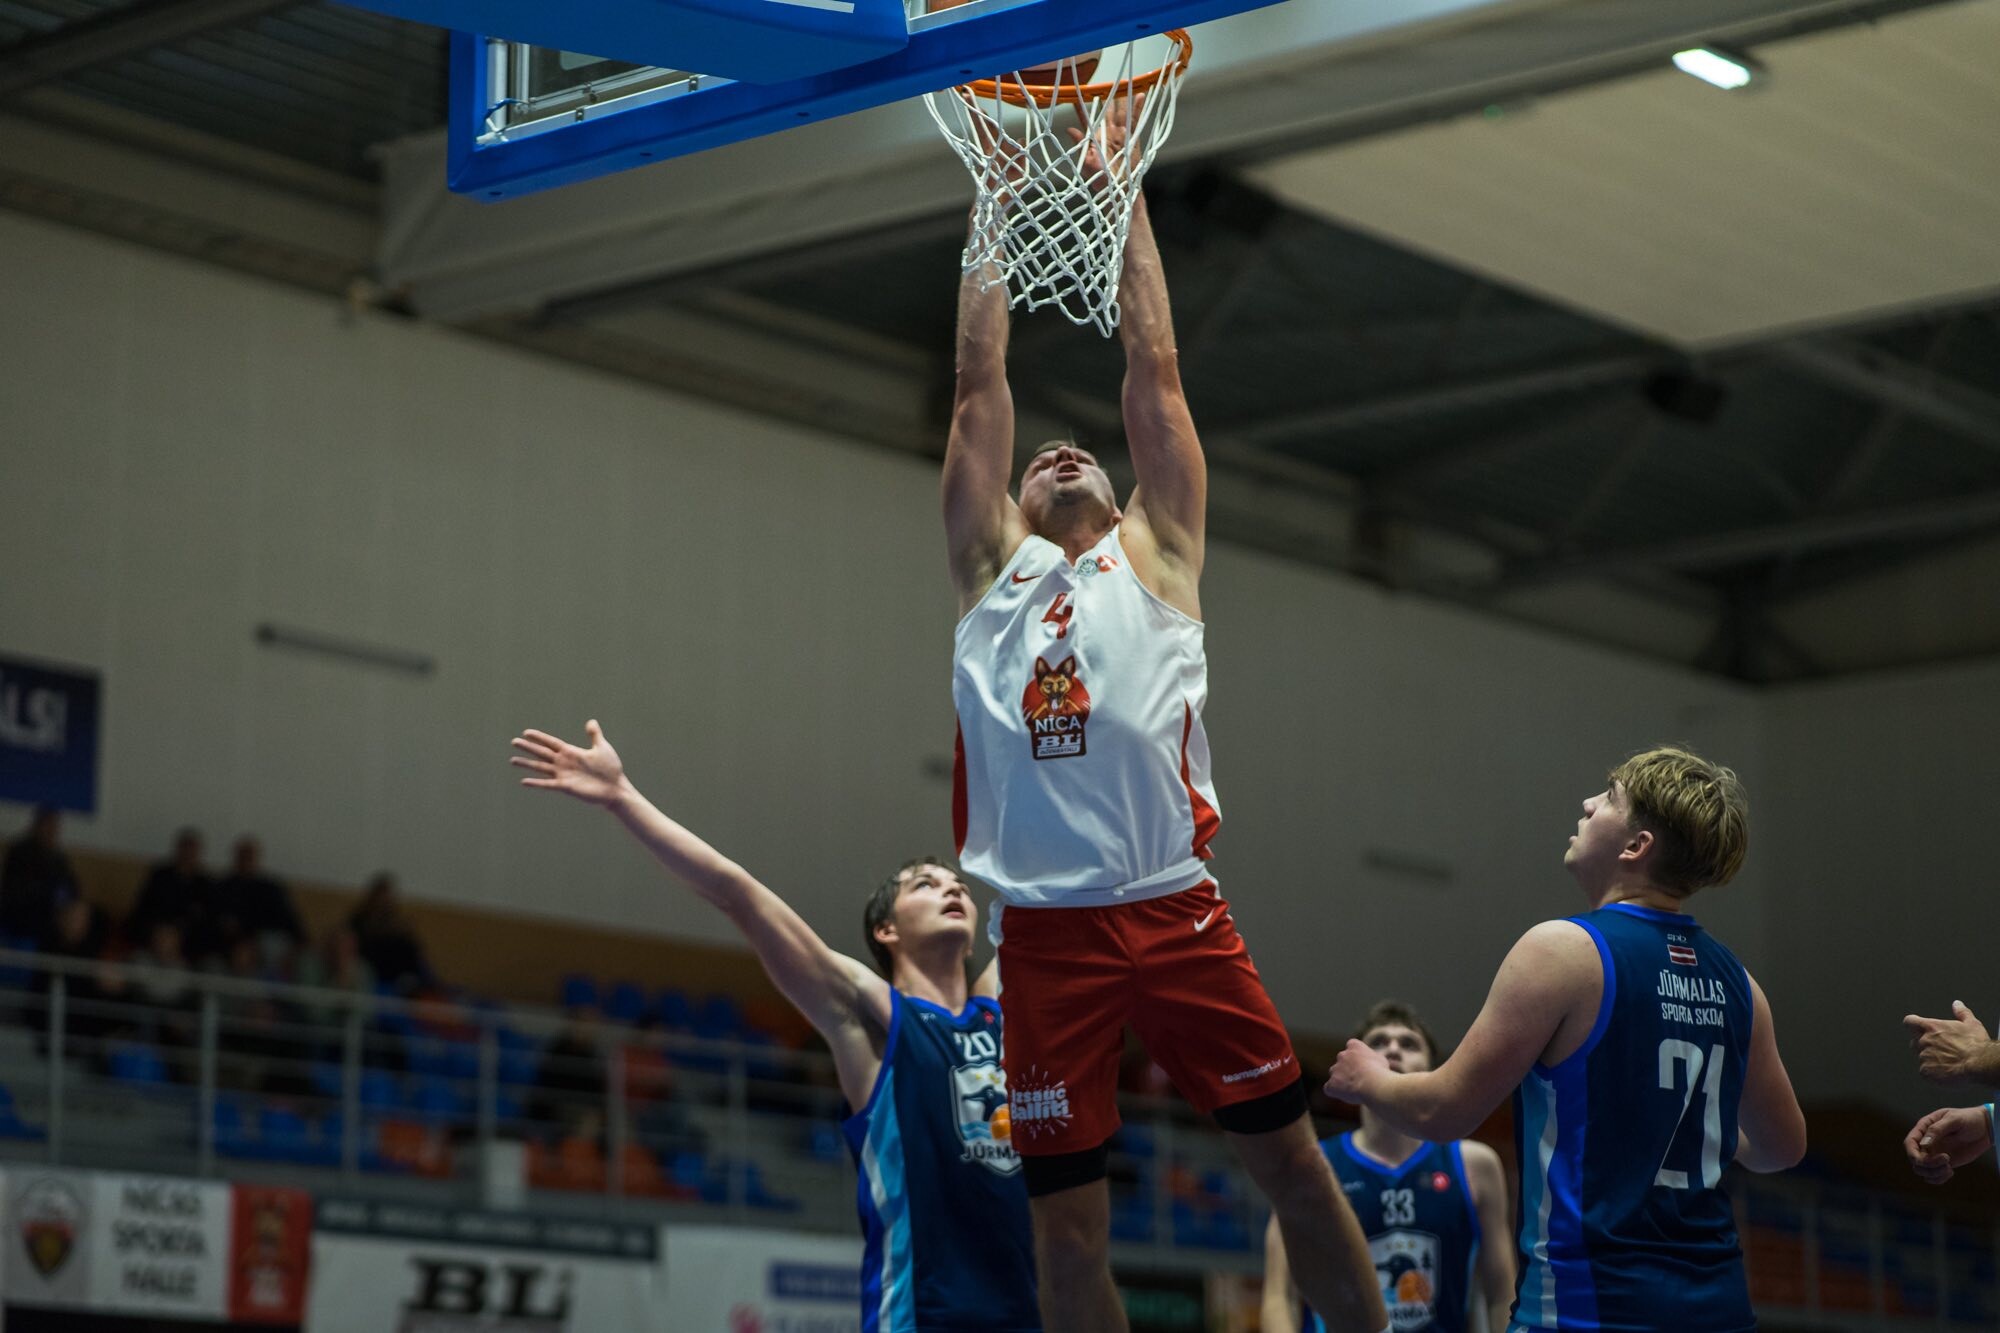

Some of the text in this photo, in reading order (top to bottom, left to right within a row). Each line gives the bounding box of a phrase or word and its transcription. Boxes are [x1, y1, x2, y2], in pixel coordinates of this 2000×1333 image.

[1040, 592, 1074, 640] 4
[1657, 969, 1726, 1005] JŪRMALAS
[953, 1030, 998, 1062] 20
[1653, 1038, 1726, 1190] 21
[1380, 1187, 1417, 1227] 33
